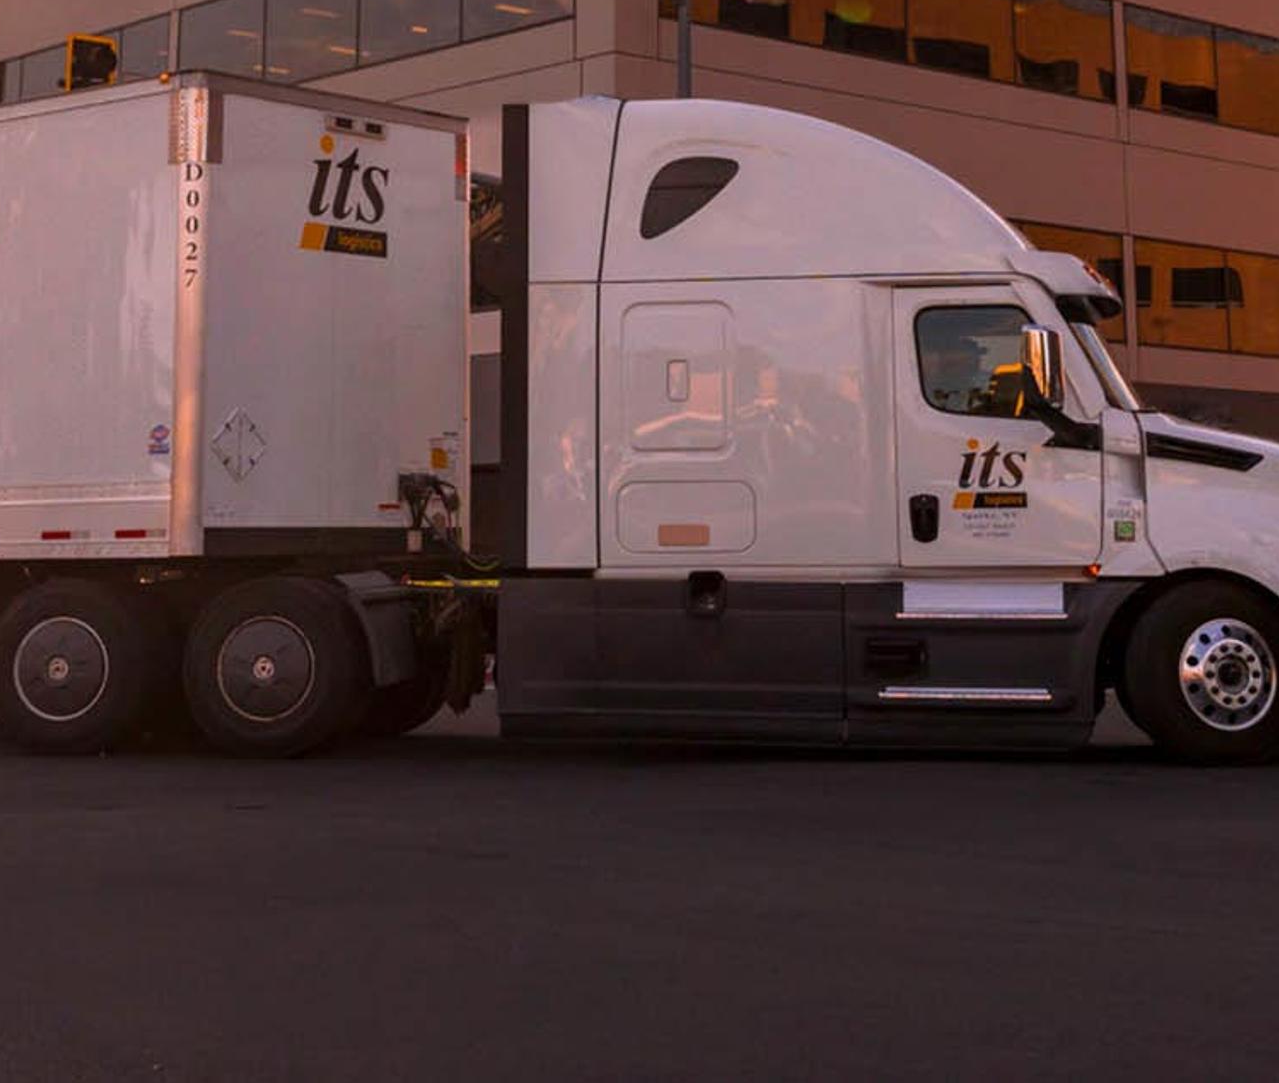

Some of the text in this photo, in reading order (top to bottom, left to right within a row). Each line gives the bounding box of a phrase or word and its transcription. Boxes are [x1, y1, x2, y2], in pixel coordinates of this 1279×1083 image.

[308, 134, 390, 224] its
[184, 162, 204, 288] D0027
[958, 438, 1027, 489] its
